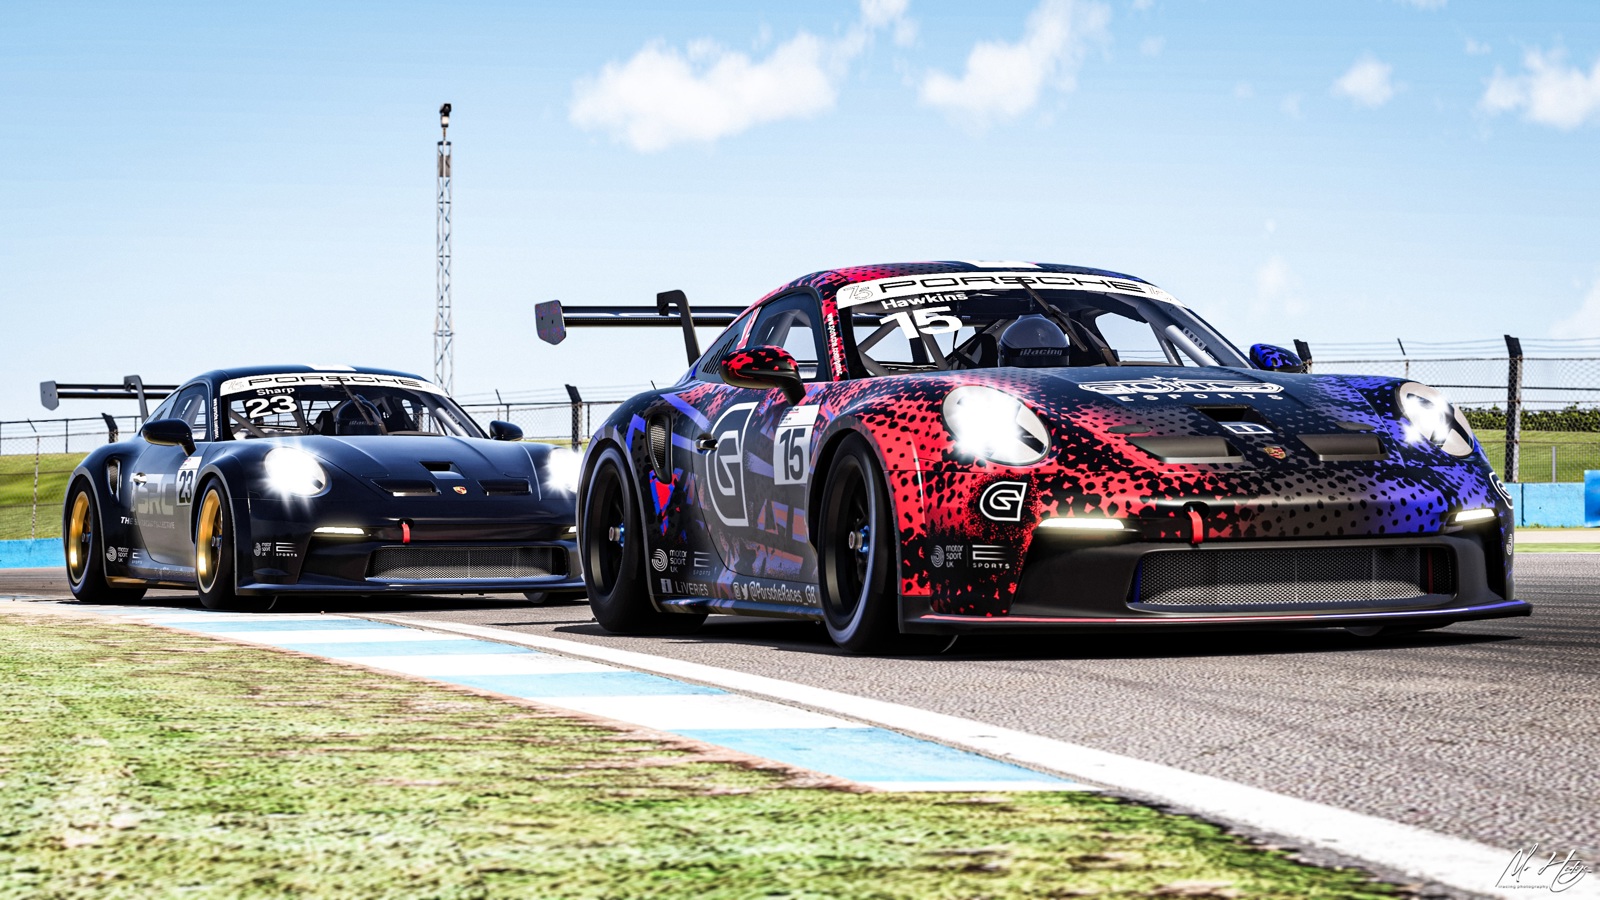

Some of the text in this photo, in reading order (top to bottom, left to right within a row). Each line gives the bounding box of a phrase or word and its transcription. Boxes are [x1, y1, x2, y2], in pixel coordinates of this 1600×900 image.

[879, 276, 1146, 293] PORSCHE
[881, 292, 969, 310] Hawkins
[879, 305, 963, 340] 15
[1019, 348, 1063, 357] iRacing
[248, 375, 422, 388] PORSCHE
[256, 387, 295, 396] Sharp
[245, 395, 298, 419] 23
[779, 427, 806, 481] 15
[178, 470, 193, 504] 23
[669, 549, 688, 557] motor
[945, 544, 964, 552] motor
[670, 558, 686, 566] sport
[748, 581, 817, 606] @PorscheRaces_GB
